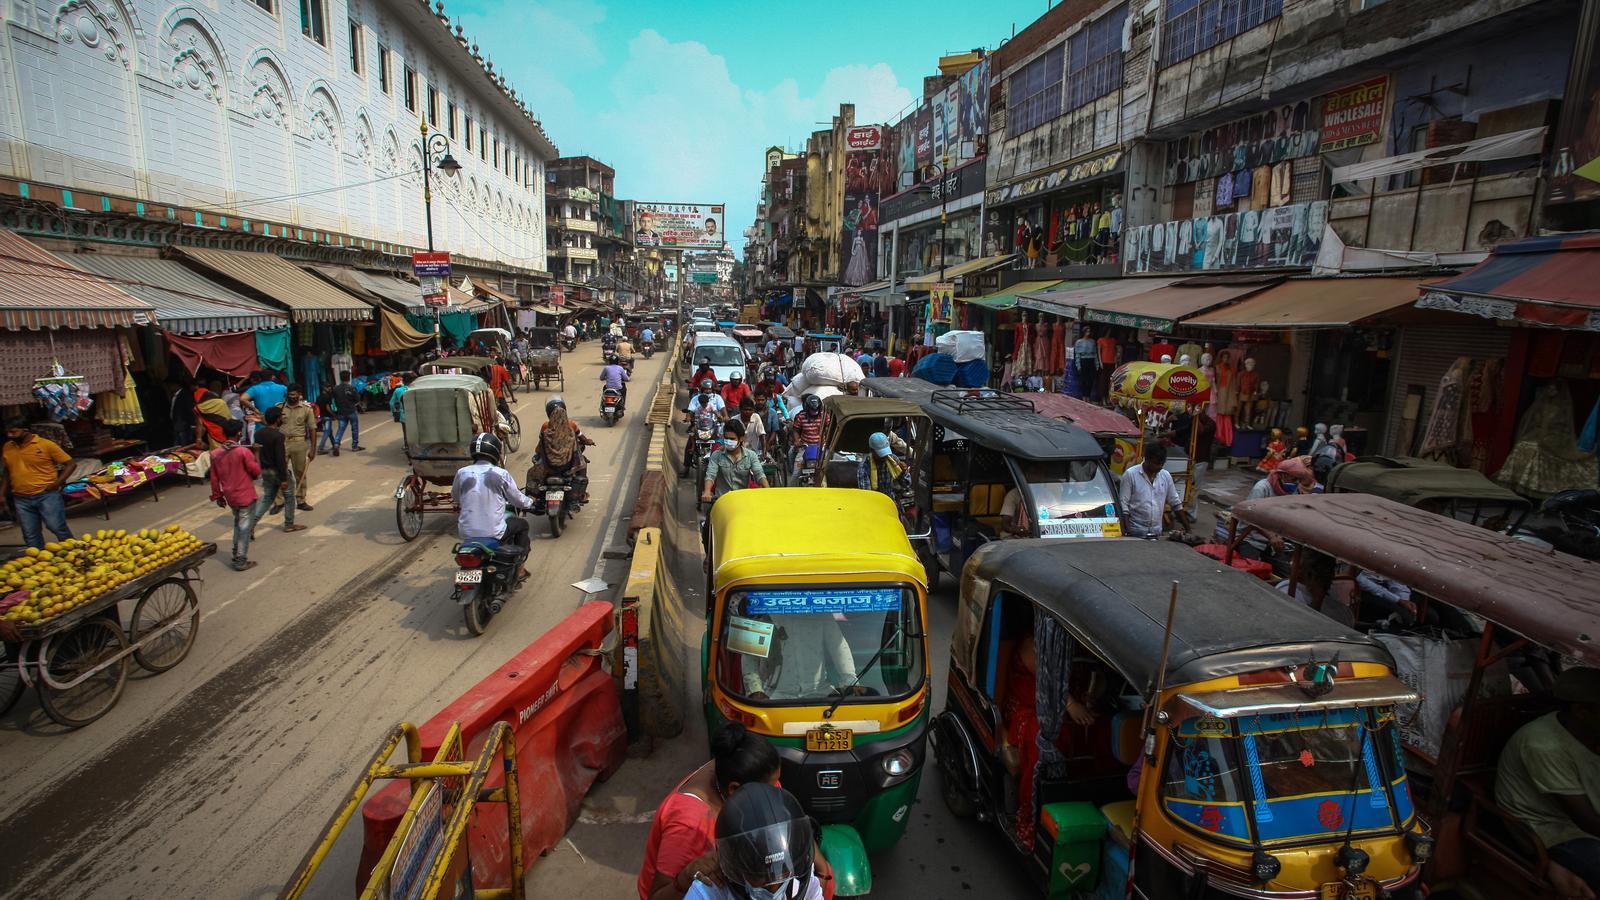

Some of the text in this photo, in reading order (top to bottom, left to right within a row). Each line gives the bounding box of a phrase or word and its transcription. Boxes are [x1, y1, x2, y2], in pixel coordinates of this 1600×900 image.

[1324, 101, 1383, 128] WHOLESALE
[1170, 375, 1197, 386] Novelty
[763, 596, 808, 607] उदय
[812, 594, 871, 606] बजाज
[817, 740, 849, 750] T1219
